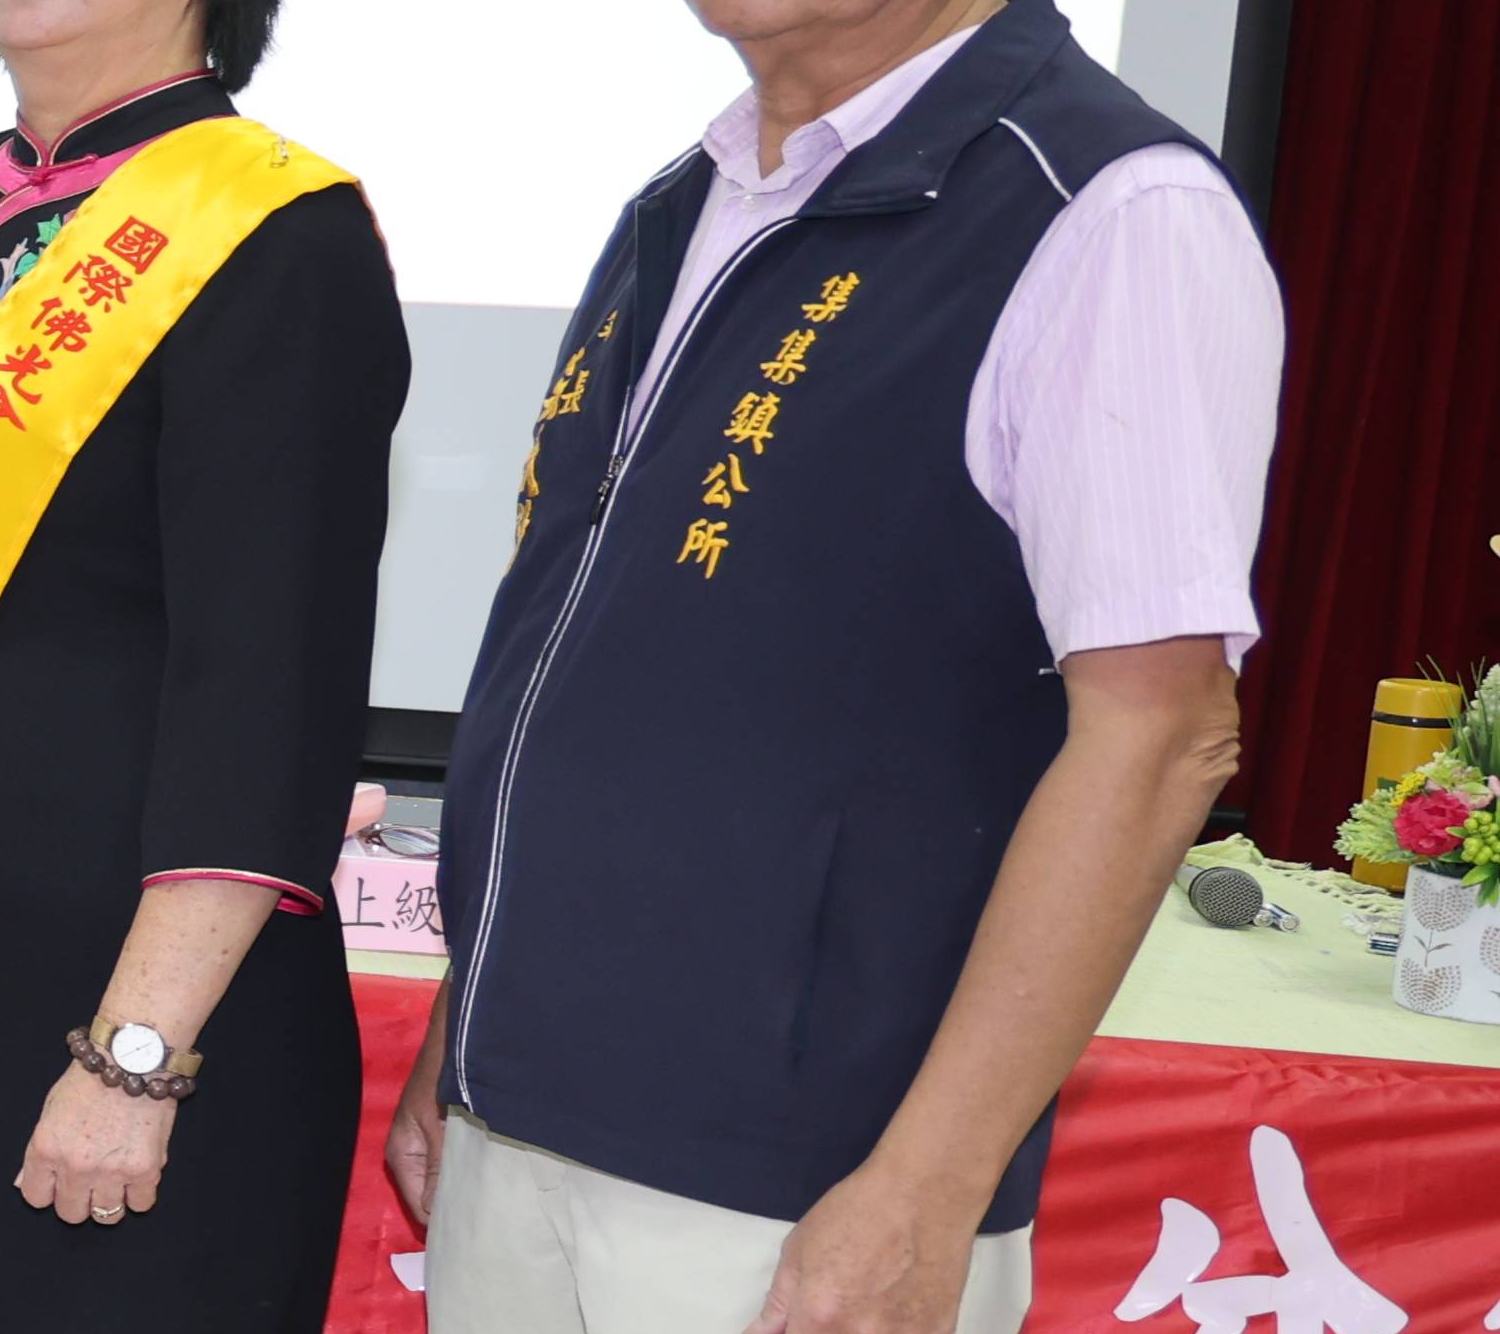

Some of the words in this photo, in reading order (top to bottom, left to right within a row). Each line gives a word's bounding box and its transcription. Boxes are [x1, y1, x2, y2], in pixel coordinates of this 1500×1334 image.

[677, 271, 861, 578] 集集鎮公所
[341, 876, 444, 936] 上級
